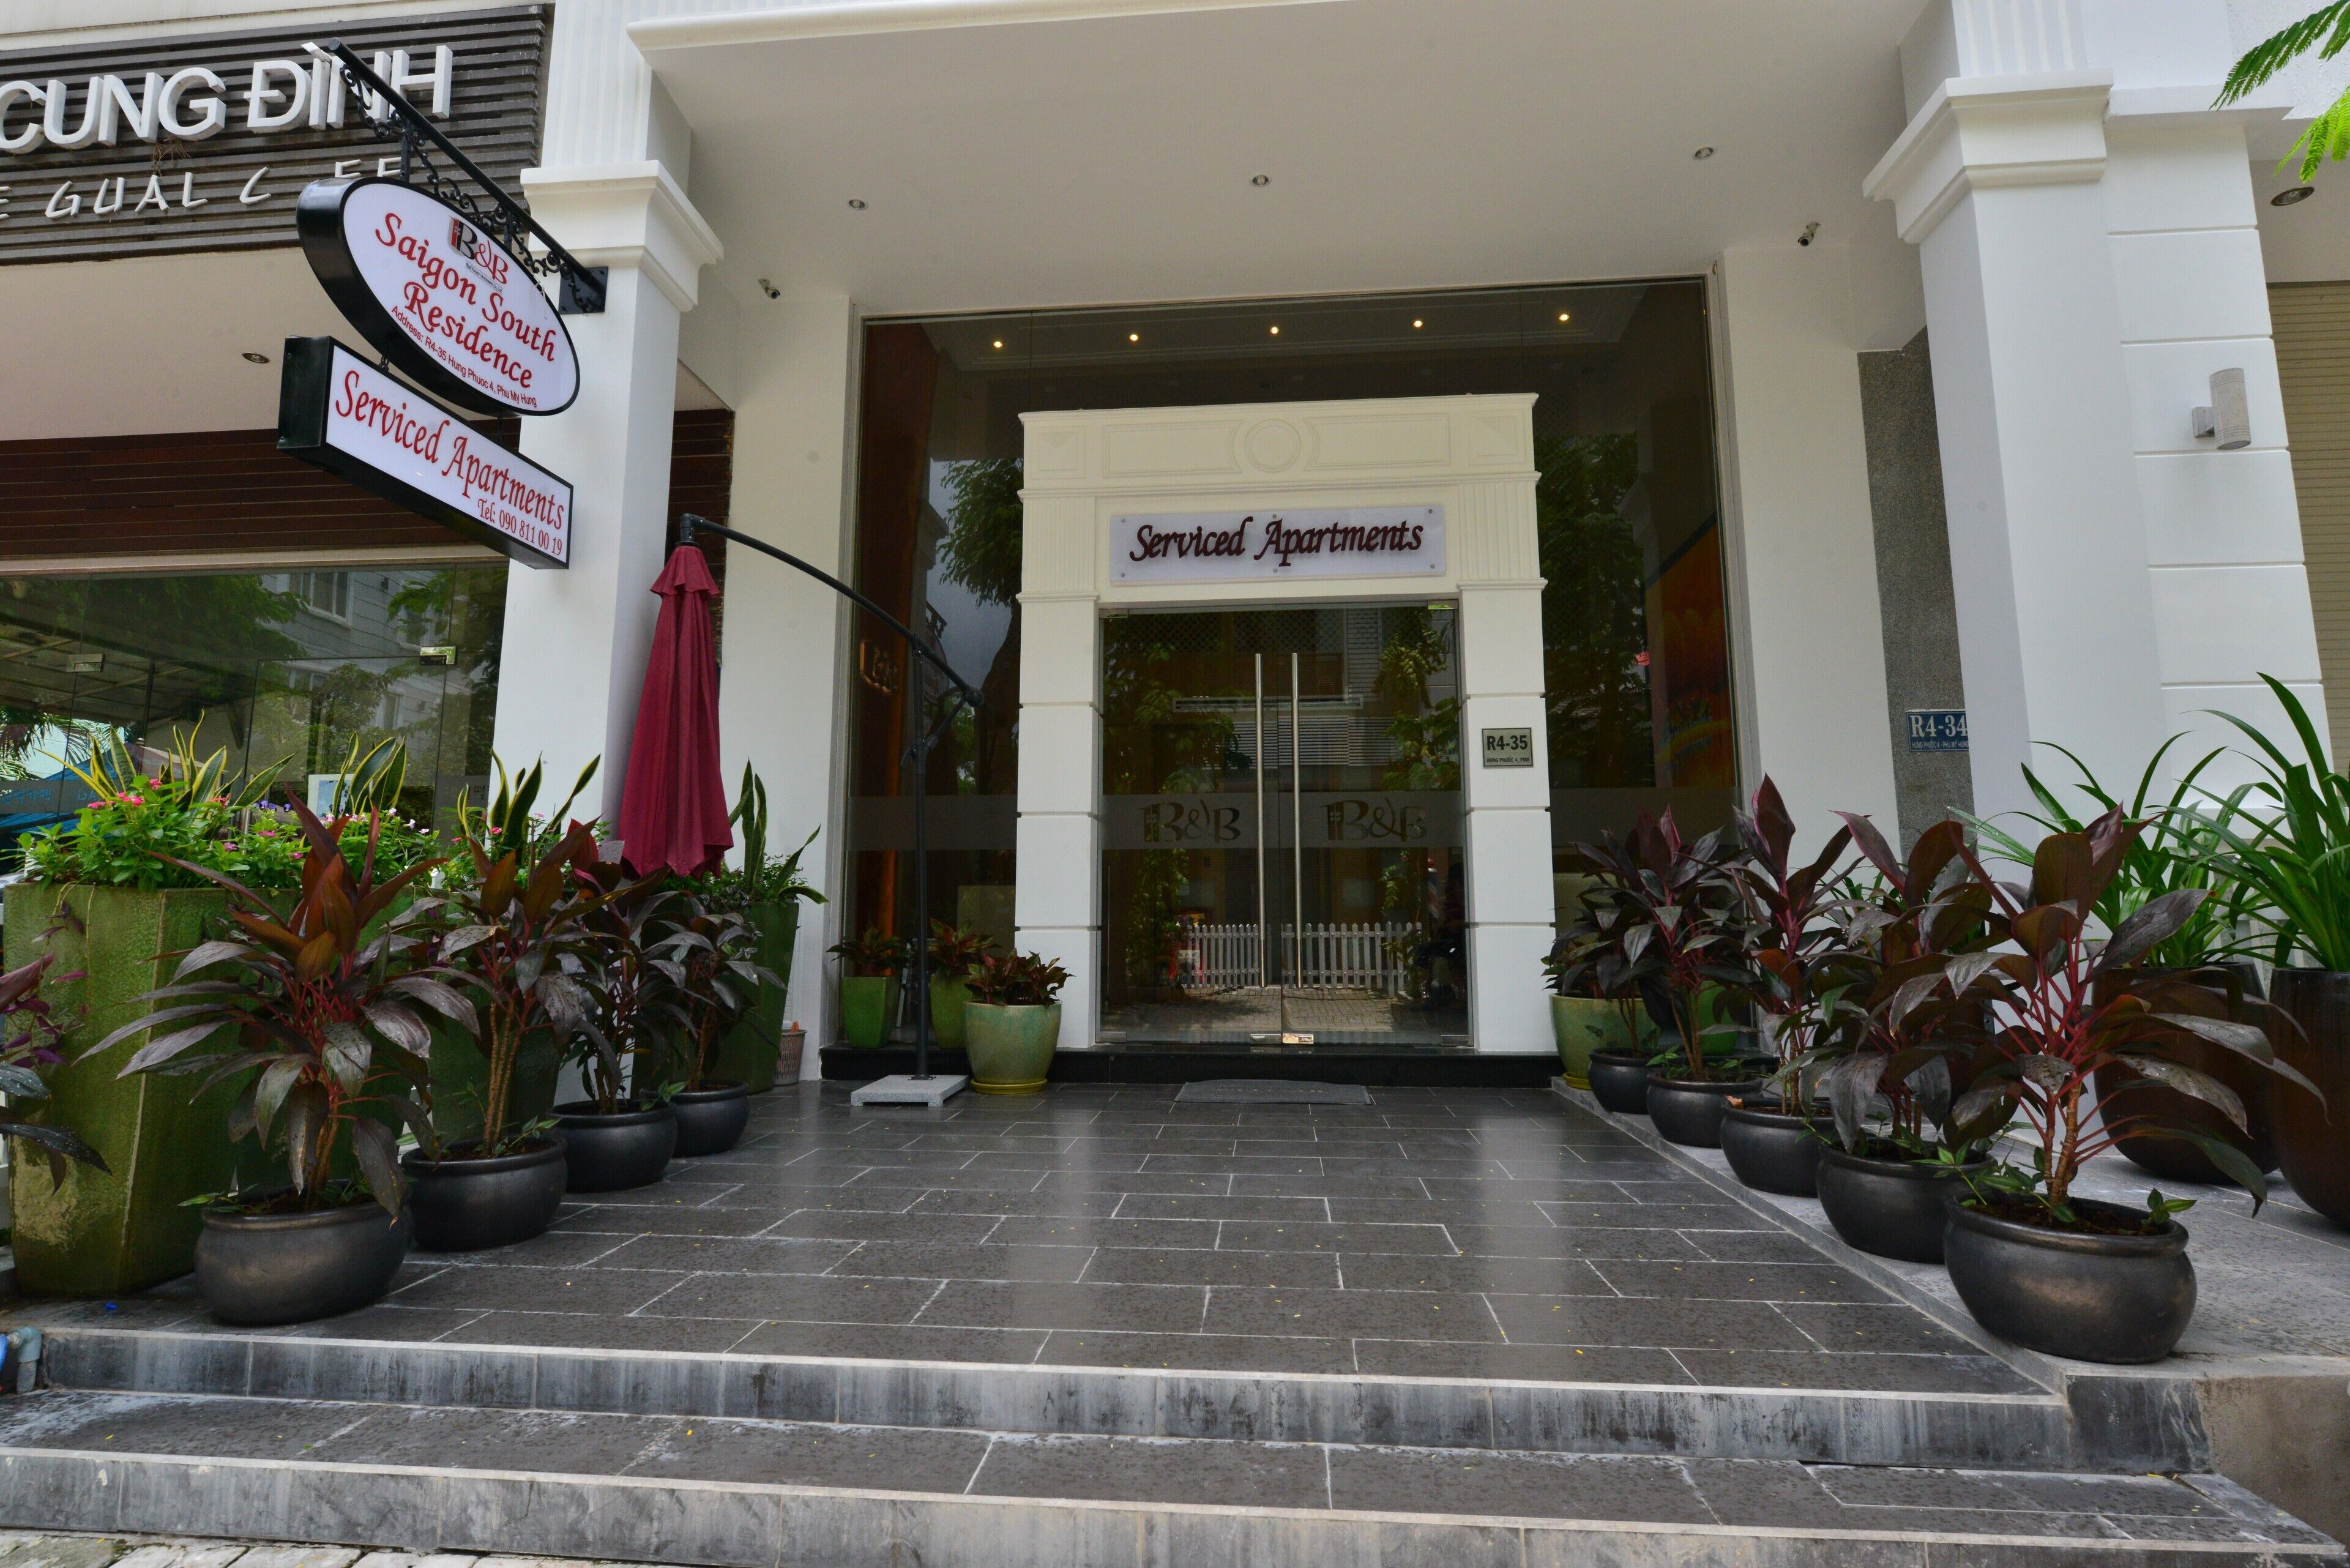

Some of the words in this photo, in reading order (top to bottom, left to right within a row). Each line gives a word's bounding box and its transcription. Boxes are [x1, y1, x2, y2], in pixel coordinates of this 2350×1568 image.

[0, 67, 227, 154] CUNG
[45, 172, 208, 218] GUAL
[449, 216, 509, 284] B&B
[375, 212, 477, 305] Saigon
[482, 292, 556, 362] South
[391, 305, 424, 343] Address:
[425, 335, 447, 361] R4-35
[448, 354, 466, 378] Hung
[467, 368, 489, 389] Phuoc
[489, 382, 496, 395] 4,
[497, 384, 510, 400] Phu
[510, 392, 520, 405] My
[521, 395, 537, 409] Hung
[404, 282, 532, 388] Residence
[335, 370, 450, 464] Serviced
[441, 436, 564, 531] Apartments
[477, 498, 496, 524] Tel:
[499, 509, 517, 534] 090
[519, 520, 535, 544] 811
[538, 529, 550, 550] 00
[551, 536, 562, 556] 19
[1129, 516, 1254, 562] Serviced
[1253, 517, 1423, 567] Apartments
[1486, 734, 1528, 750] R4-35
[1909, 714, 1968, 738] R4-34
[1135, 799, 1241, 843] B&B
[1321, 797, 1428, 843] B&B
